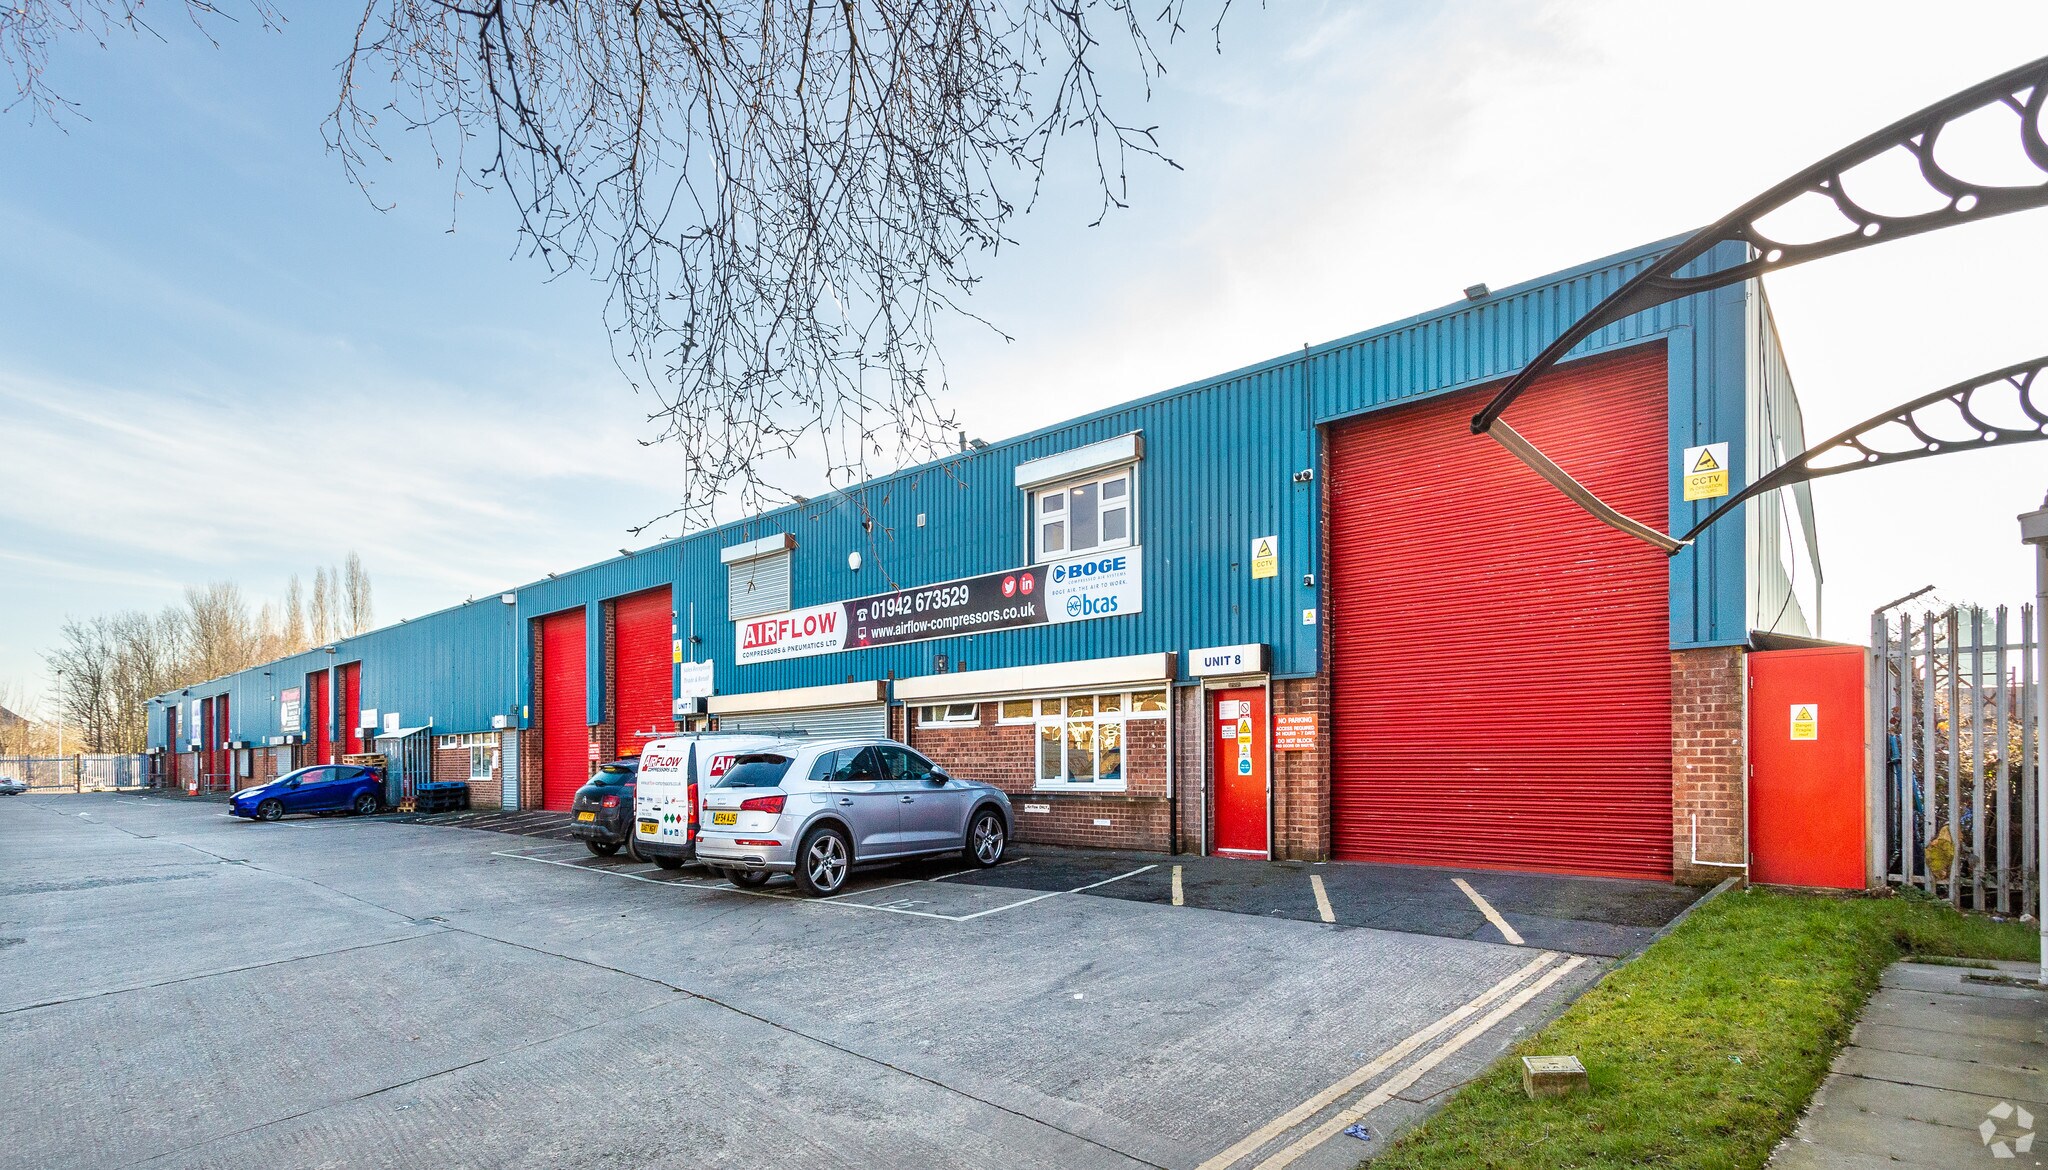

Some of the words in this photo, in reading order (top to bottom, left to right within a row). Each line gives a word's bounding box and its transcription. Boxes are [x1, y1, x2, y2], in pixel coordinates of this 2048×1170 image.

[1692, 475, 1720, 485] CCTV
[1069, 556, 1126, 578] BOGE
[1068, 576, 1096, 584] COMPRESSED
[872, 596, 912, 620] 01942
[916, 584, 970, 612] 673529
[1083, 594, 1118, 616] bcas
[744, 612, 837, 648] AIRFLOW
[871, 602, 1035, 639] www.airflow-compressors.co.uk
[742, 647, 780, 658] COMPRESSORS
[788, 642, 824, 652] PNEUMATICS
[1204, 656, 1230, 667] UNIT
[1234, 655, 1241, 665] 8
[643, 755, 682, 767] AIRFLOW
